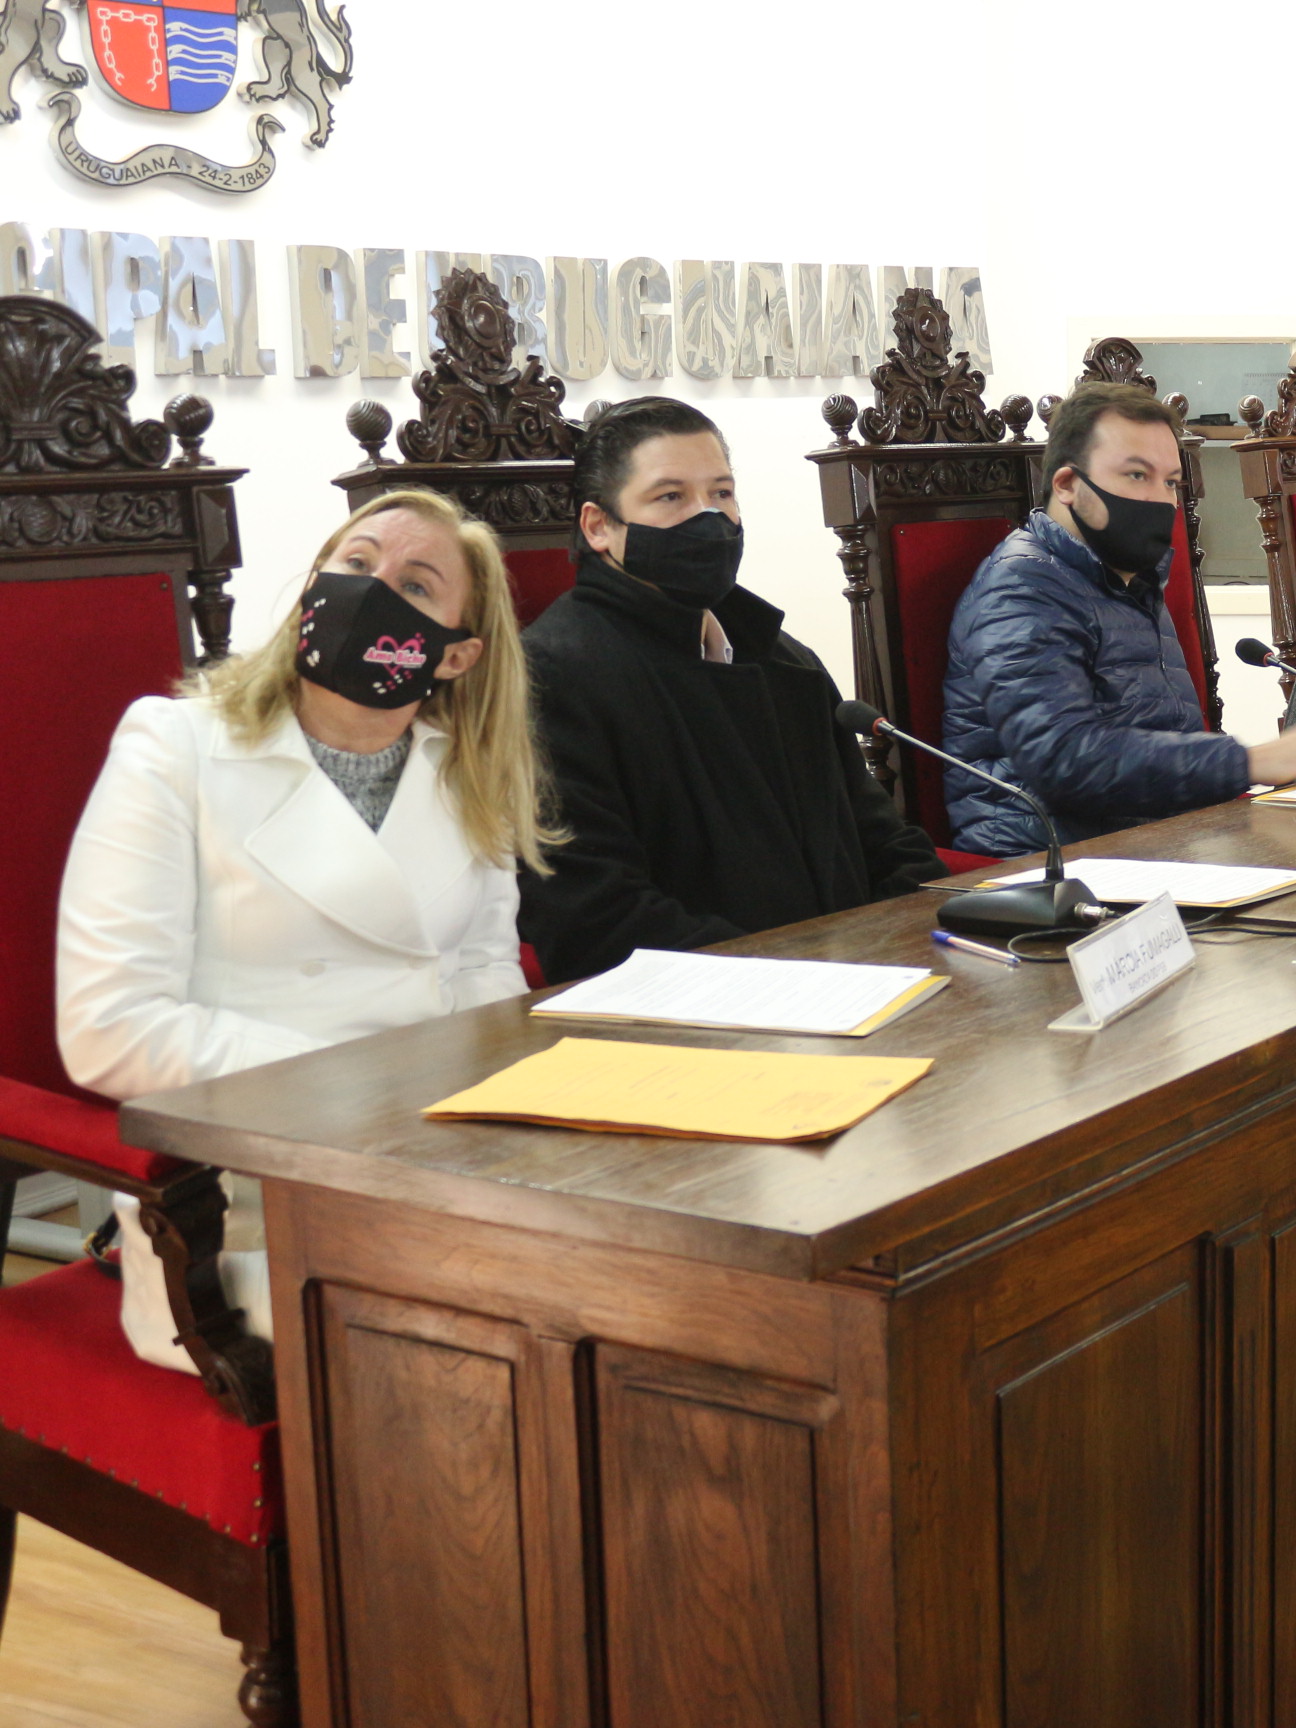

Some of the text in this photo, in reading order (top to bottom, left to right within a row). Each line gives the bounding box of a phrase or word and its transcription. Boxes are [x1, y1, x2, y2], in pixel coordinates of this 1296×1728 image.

[64, 141, 181, 182] URUGUAIANA
[198, 162, 271, 187] 24-2-1843
[287, 245, 412, 380] DE
